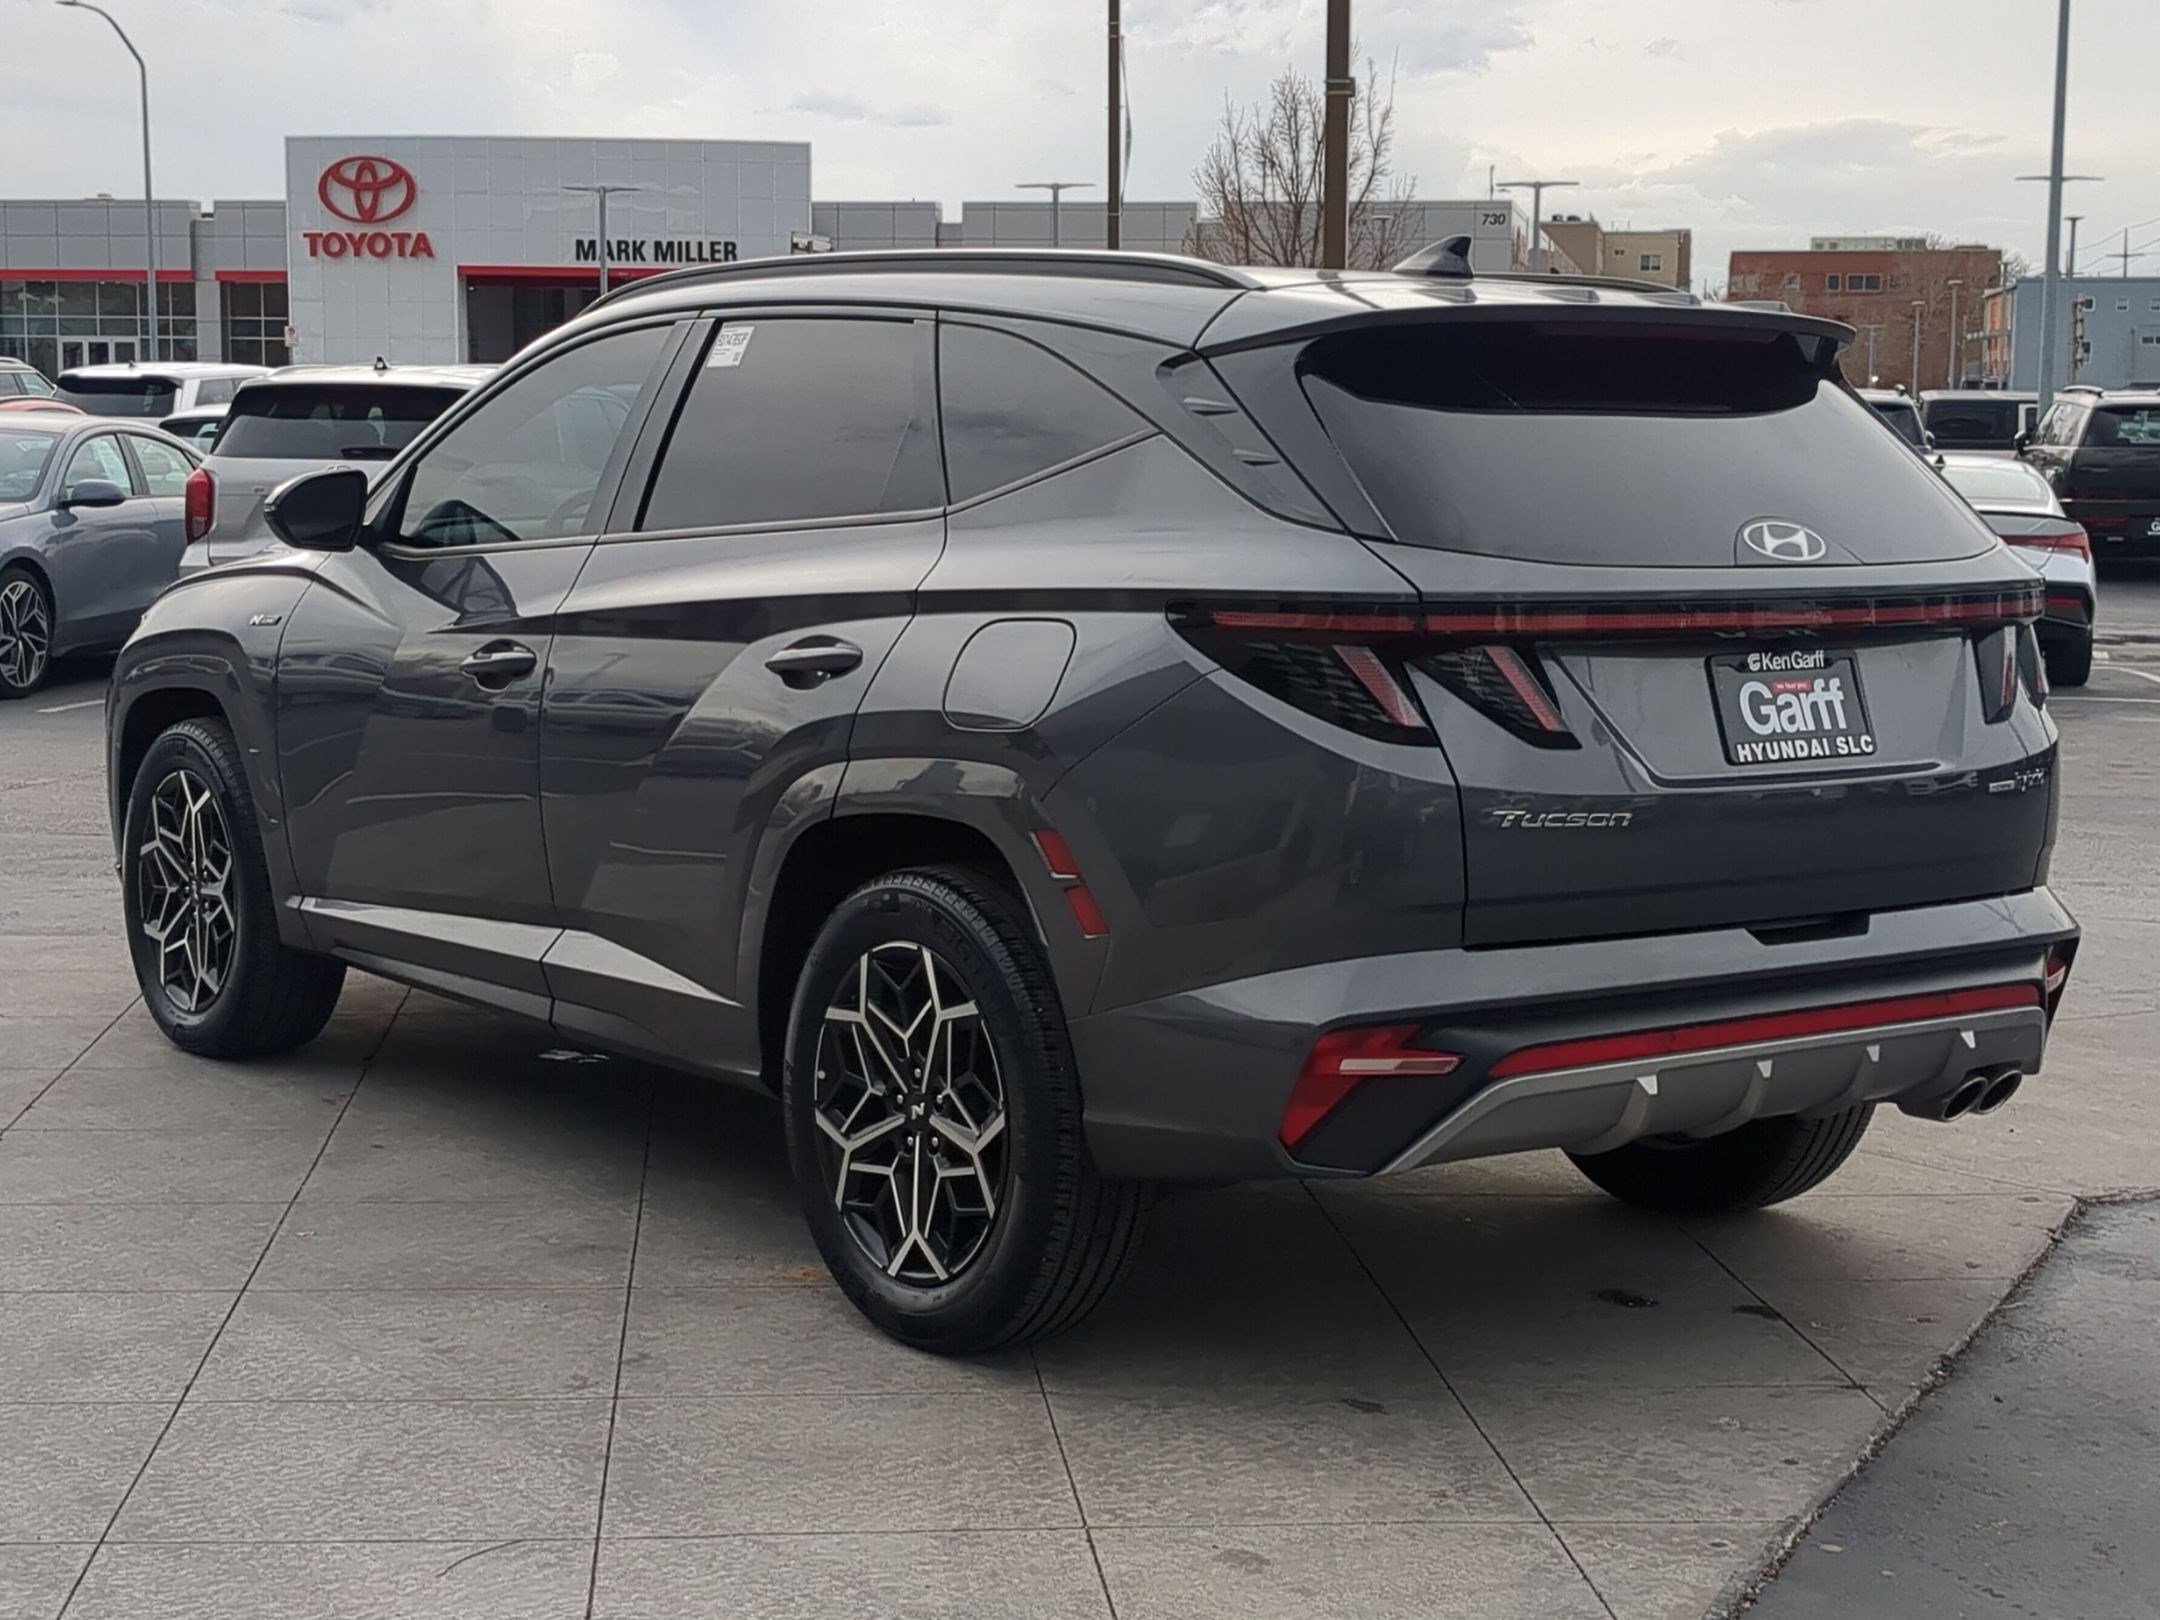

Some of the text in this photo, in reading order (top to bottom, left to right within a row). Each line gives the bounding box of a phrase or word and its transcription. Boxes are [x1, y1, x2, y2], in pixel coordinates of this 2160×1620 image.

[1482, 213, 1506, 226] 730
[303, 232, 434, 258] TOYOTA
[654, 240, 737, 263] MILLER
[1739, 677, 1847, 736] Garff
[1736, 734, 1874, 763] HYUNDAI SLC
